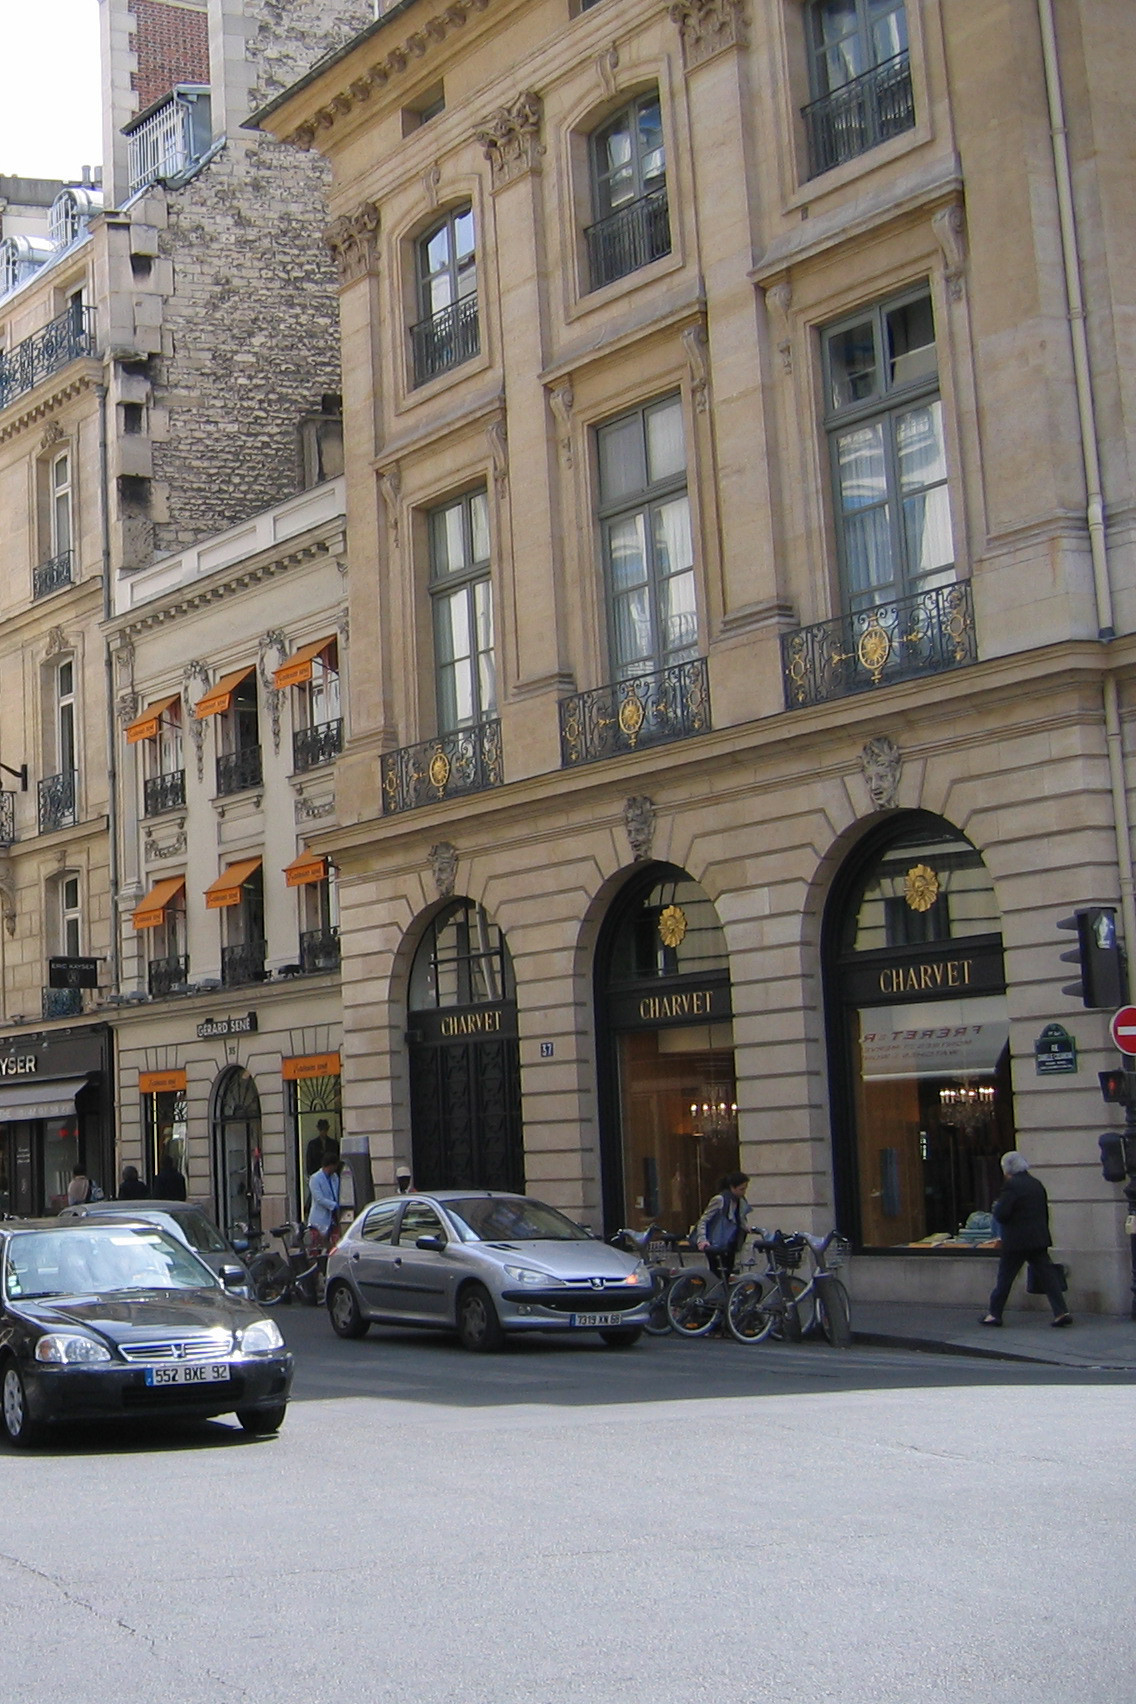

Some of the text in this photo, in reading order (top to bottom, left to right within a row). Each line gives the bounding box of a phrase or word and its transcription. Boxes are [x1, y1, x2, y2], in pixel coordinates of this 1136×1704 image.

[879, 959, 973, 994] CHARVET
[639, 991, 713, 1020] CHARVET
[440, 1010, 502, 1037] CHARVET
[541, 1043, 553, 1057] 37
[155, 1365, 227, 1383] 552 BXE 92
